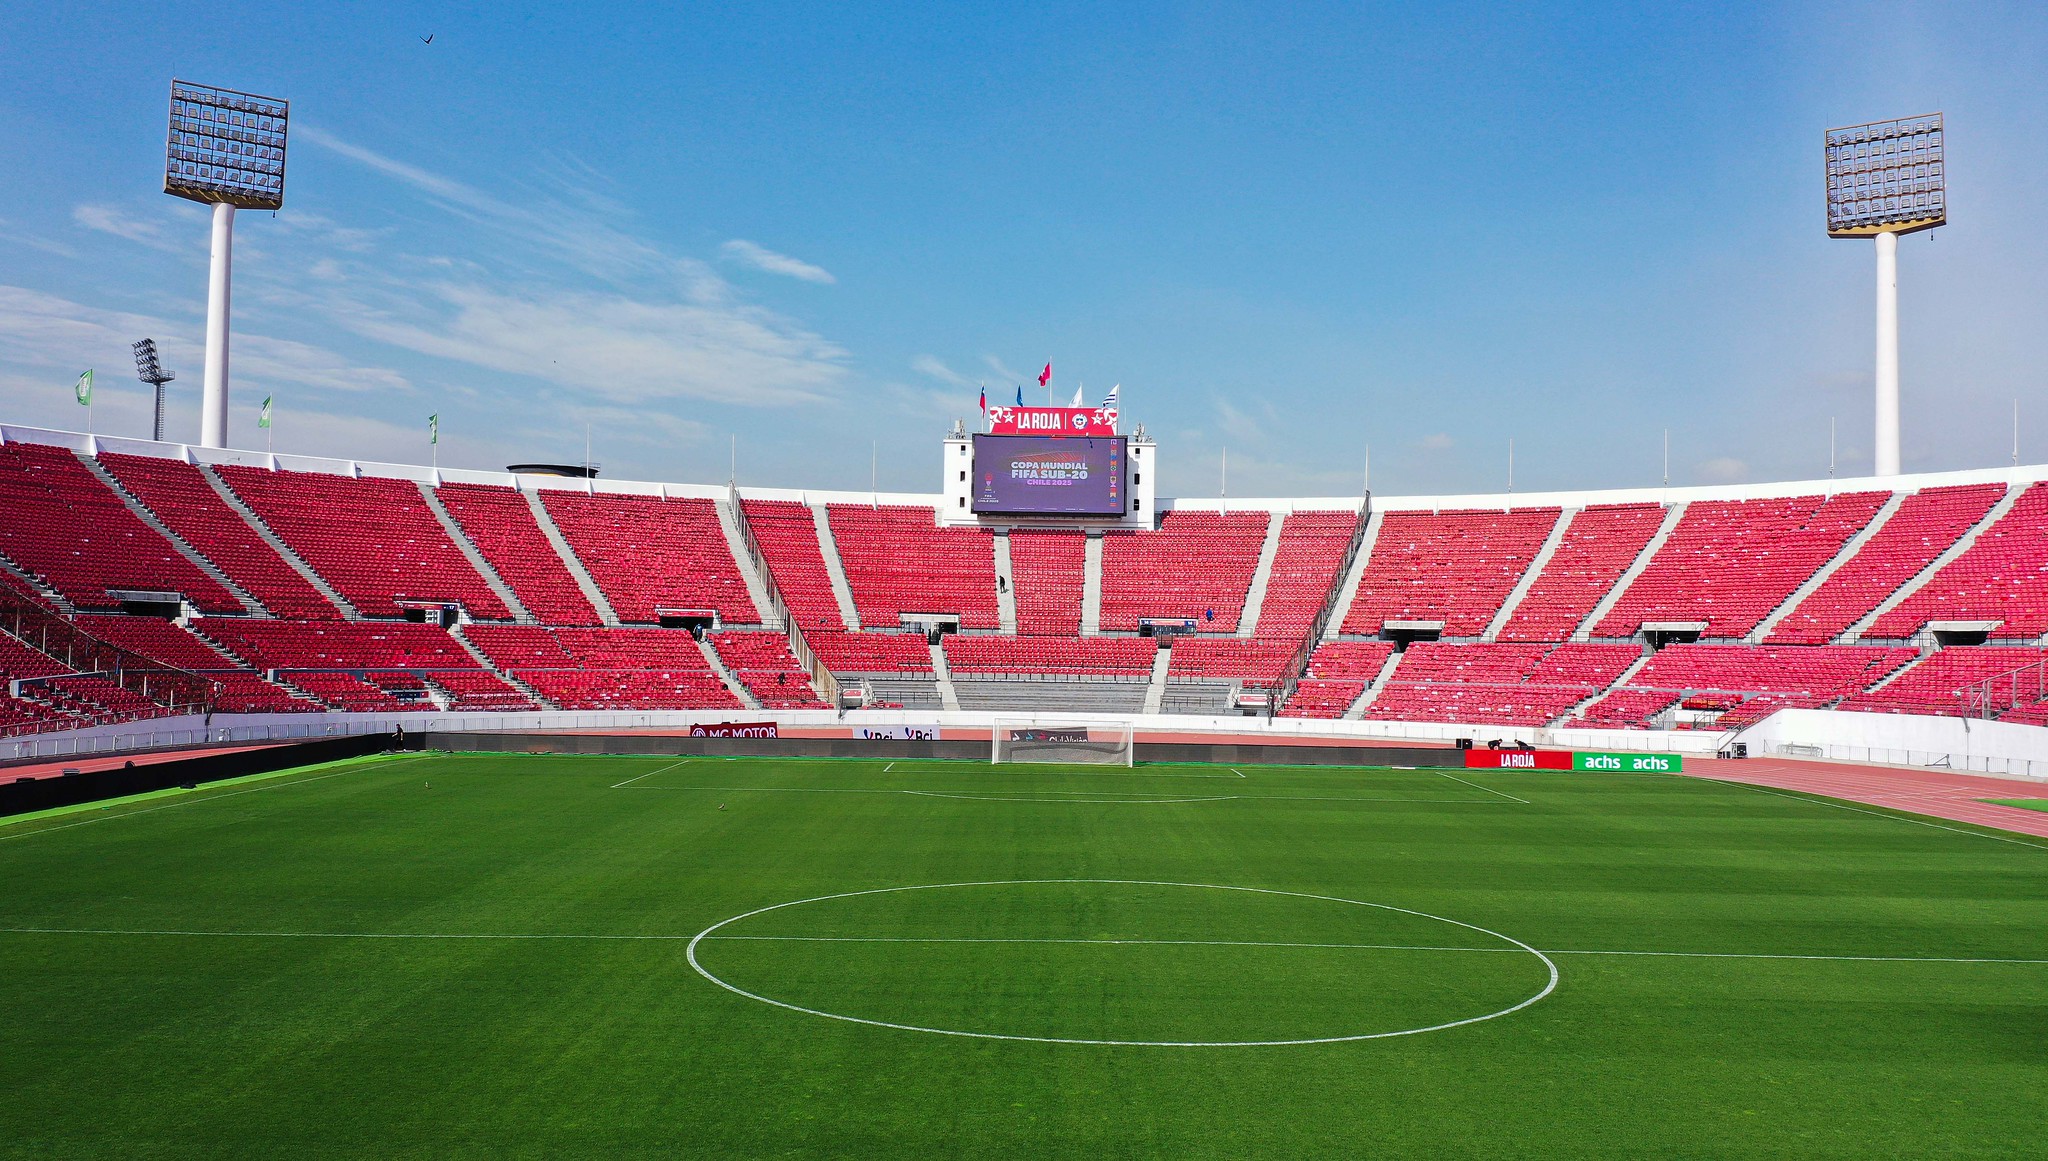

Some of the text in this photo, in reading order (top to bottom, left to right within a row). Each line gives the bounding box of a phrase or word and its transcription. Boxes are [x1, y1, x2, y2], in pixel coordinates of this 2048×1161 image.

[1017, 412, 1061, 430] LA ROJA
[1010, 461, 1088, 470] COPA MUNDIAL
[1011, 469, 1088, 480] FIFA SUB-20
[732, 727, 777, 738] MOTOR
[1501, 754, 1511, 767] LA
[1585, 755, 1621, 769] achs
[1633, 756, 1669, 770] achs
